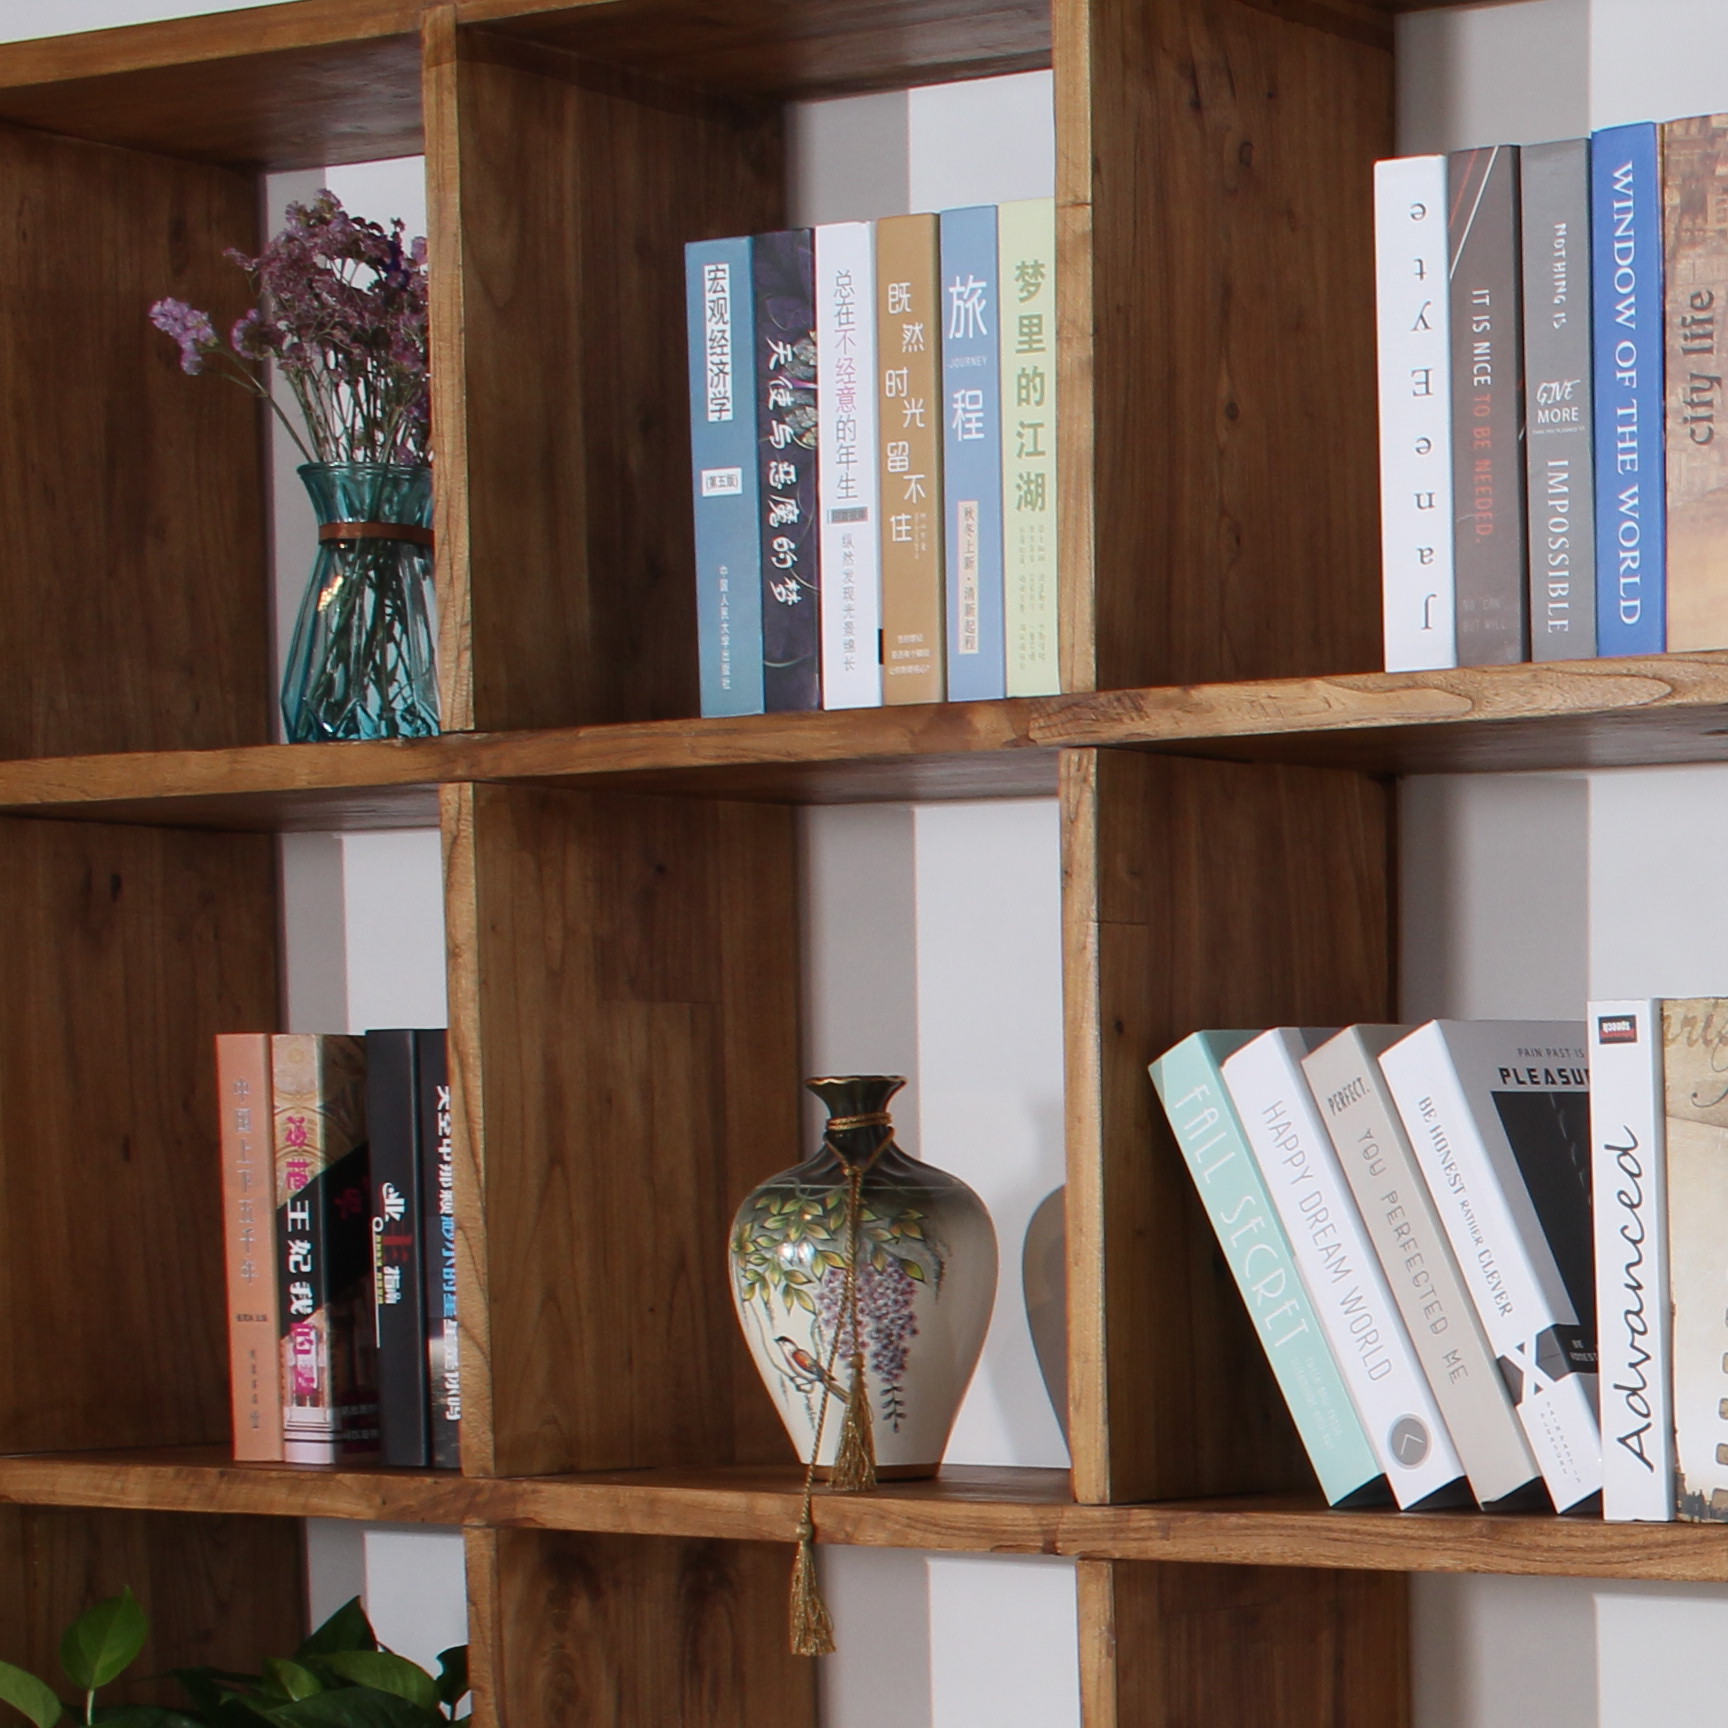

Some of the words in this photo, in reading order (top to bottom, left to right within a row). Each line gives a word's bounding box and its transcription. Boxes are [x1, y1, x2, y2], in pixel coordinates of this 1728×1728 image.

[1470, 288, 1491, 306] IT
[1552, 222, 1568, 305] NOTHING
[1612, 161, 1637, 331] WINDOW
[705, 264, 732, 421] 宏观经济学
[833, 270, 859, 501] 总在不经意的年生
[949, 274, 988, 442] 旅程
[1015, 260, 1048, 513] 梦里的江湖
[1471, 315, 1491, 333] IS
[1472, 341, 1493, 387] NICE
[1553, 312, 1566, 330] IS
[1614, 343, 1637, 387] OF
[1680, 289, 1716, 357] life
[885, 282, 928, 544] 既然时光留不住
[1473, 395, 1493, 417] TO
[1473, 427, 1494, 450] BE
[1537, 380, 1581, 406] GIVE
[1537, 408, 1579, 424] MORE
[1615, 400, 1639, 477] THE
[1685, 373, 1723, 446] city
[764, 337, 804, 609] 天使与恶魔的梦
[1547, 459, 1569, 634] IMPOSSIBLE
[1618, 484, 1641, 626] WORLD
[718, 565, 732, 691] 中国人民大学出版社
[232, 1078, 257, 1285] 中国上下五千年
[1173, 1083, 1233, 1185] FALL
[1221, 1194, 1310, 1349] SECRET
[1260, 1099, 1313, 1185] HAPPY
[1297, 1190, 1353, 1285] DREAM
[1339, 1286, 1395, 1383] WORLD
[1417, 1096, 1438, 1127] BE
[1431, 1126, 1467, 1196] HONEST
[1458, 1197, 1486, 1248] RATHER
[1477, 1247, 1513, 1319] CLEVER
[1355, 1127, 1386, 1177] YOU
[1378, 1191, 1449, 1336] PERFECTED
[1442, 1348, 1468, 1386] ME
[1603, 1124, 1655, 1473] Advanced
